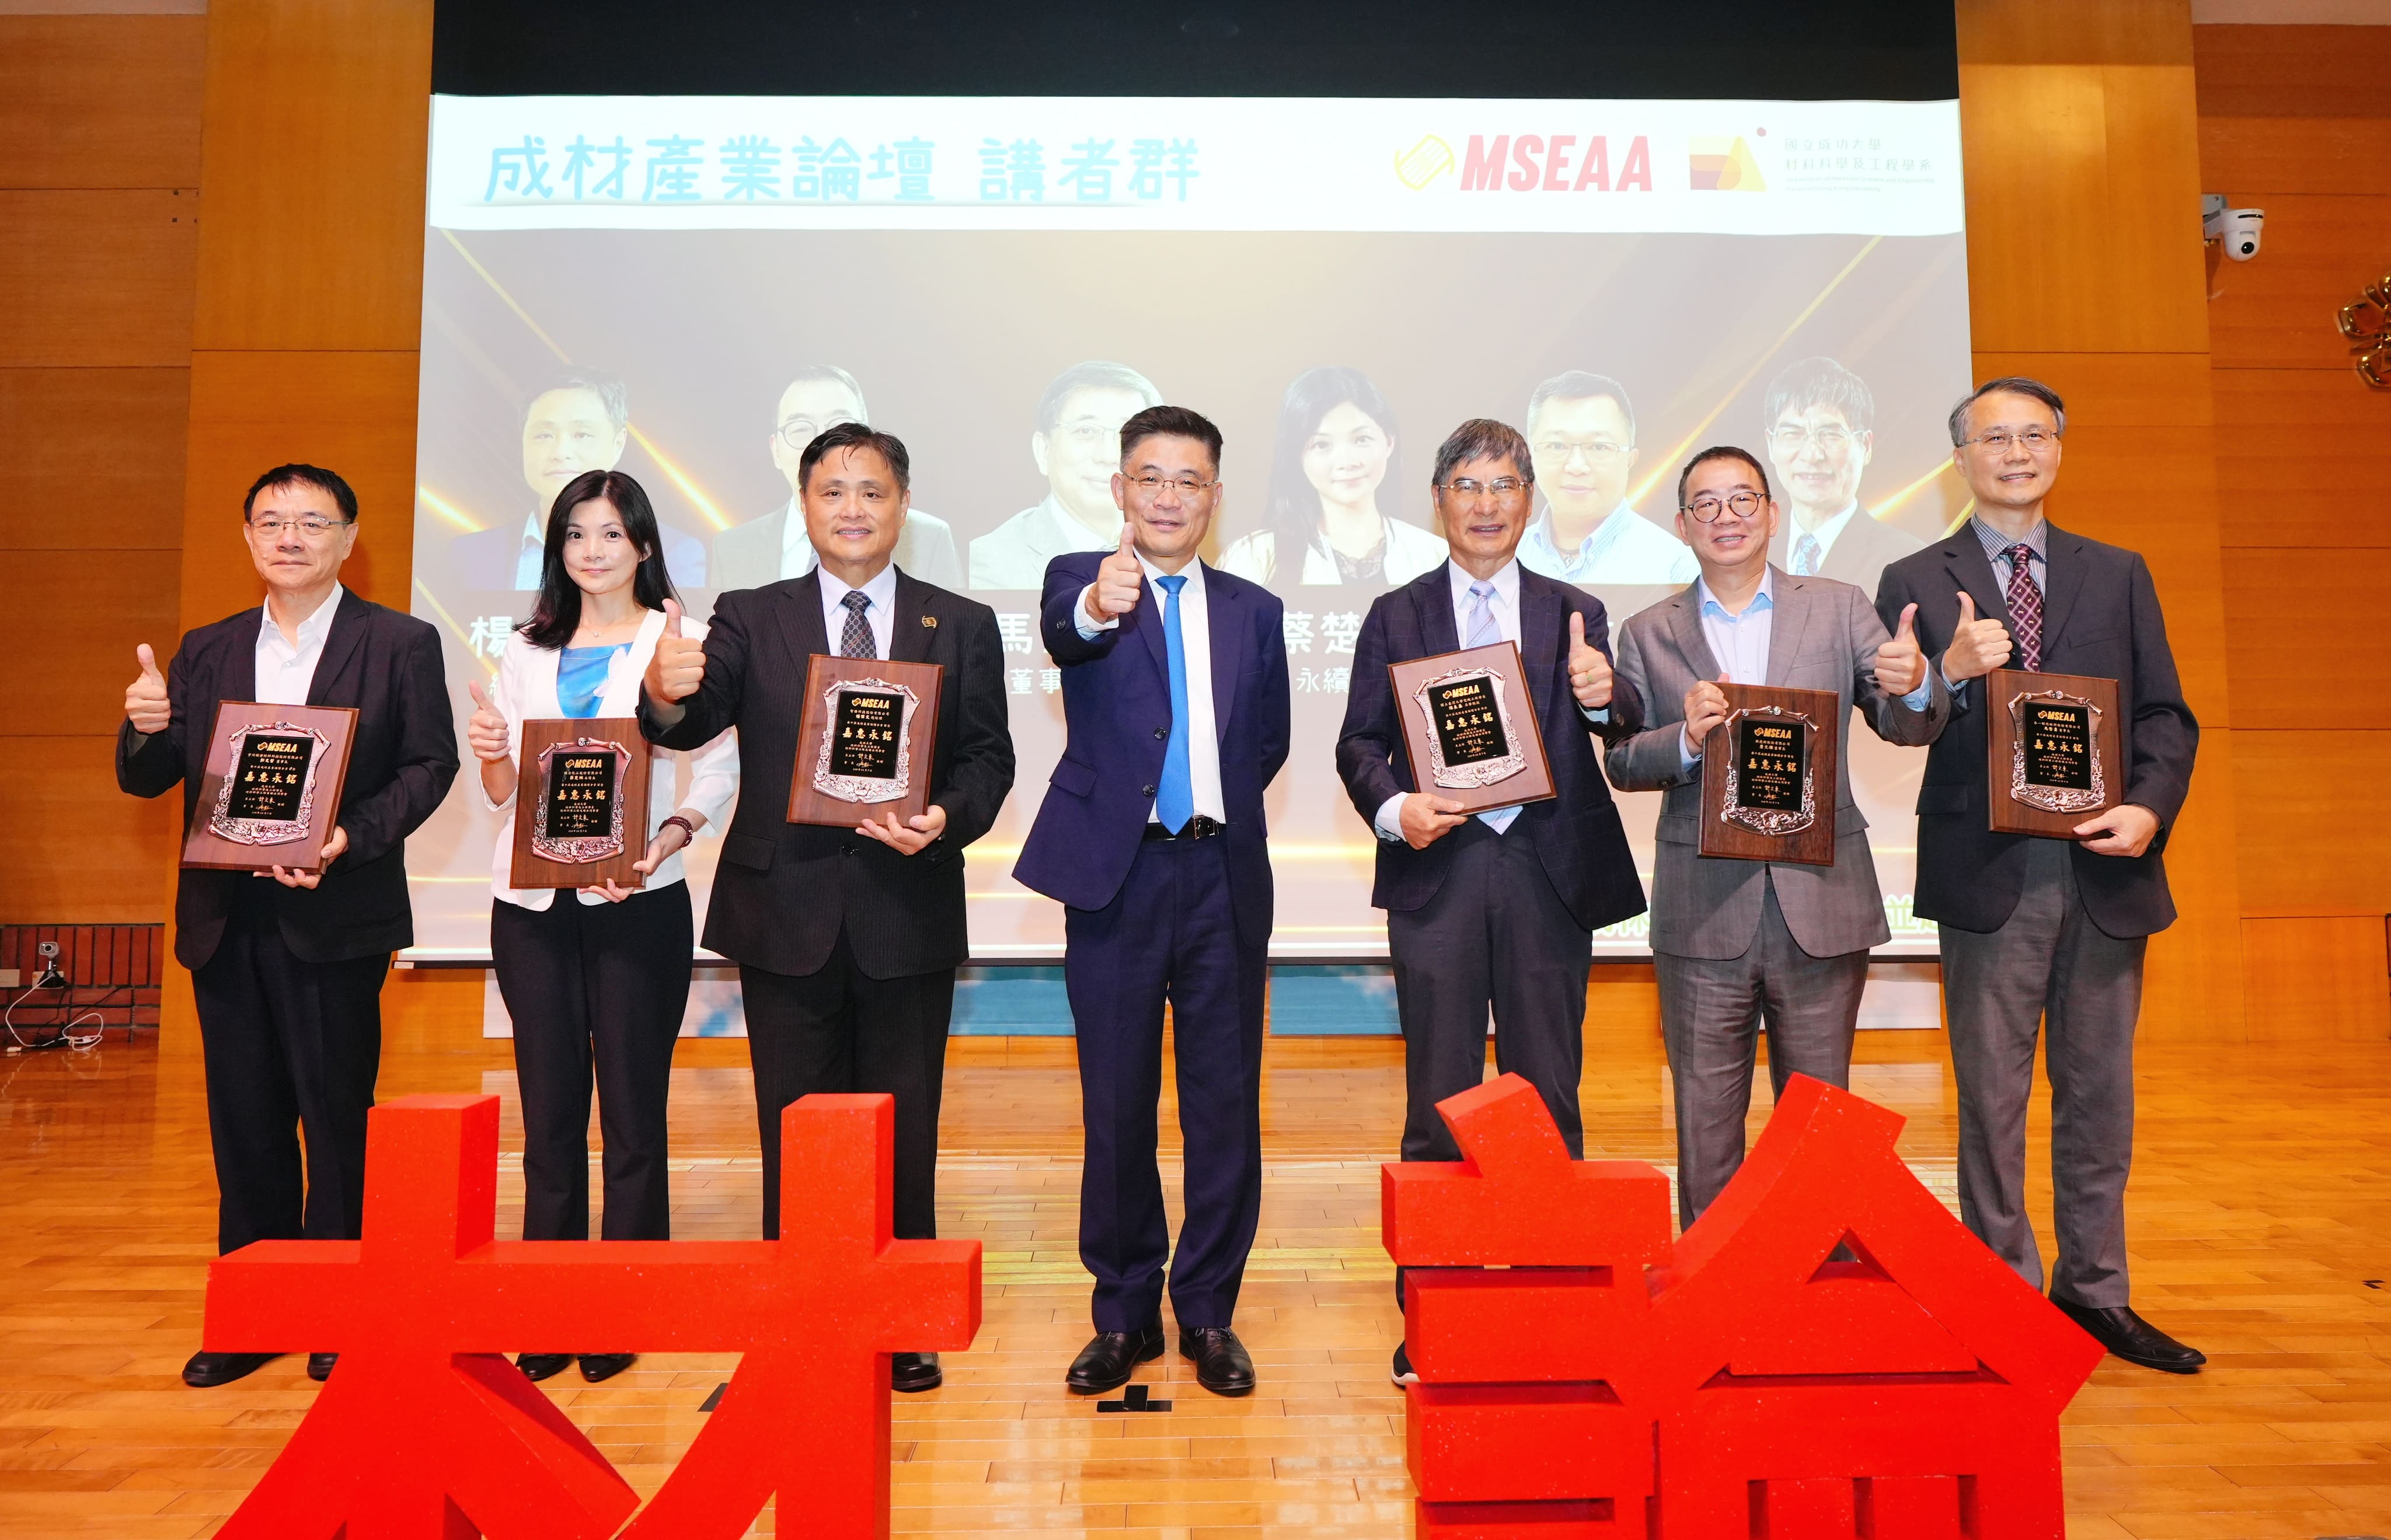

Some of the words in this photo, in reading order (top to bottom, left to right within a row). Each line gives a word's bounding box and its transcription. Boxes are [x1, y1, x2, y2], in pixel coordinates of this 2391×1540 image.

[1784, 137, 1881, 151] 國立成功大學
[484, 134, 936, 202] 成材產業論壇
[978, 137, 1200, 202] 講者群
[1459, 134, 1653, 191] MSEAA
[1786, 157, 1932, 172] 材料科學及工程學系
[469, 616, 513, 658] 楊
[1283, 611, 1360, 654] 蔡楚
[1009, 668, 1061, 694] 董事
[1296, 666, 1350, 693] 永續
[1452, 685, 1480, 698] MSEAA
[860, 698, 890, 709] MSEAA
[1445, 712, 1493, 731] 嘉惠永銘
[2047, 711, 2075, 722] MSEAA
[842, 727, 893, 741] 嘉惠永銘
[1763, 728, 1791, 739] MSEAA
[266, 742, 298, 752] MSEAA
[2033, 738, 2082, 753] 嘉惠永銘
[574, 759, 602, 767] MSEAA
[1747, 757, 1796, 772] 嘉惠永銘
[243, 770, 298, 784] 嘉惠永銘
[557, 789, 605, 800] 嘉惠永銘
[201, 1093, 983, 1540] 材
[1381, 1072, 2108, 1540] 論
